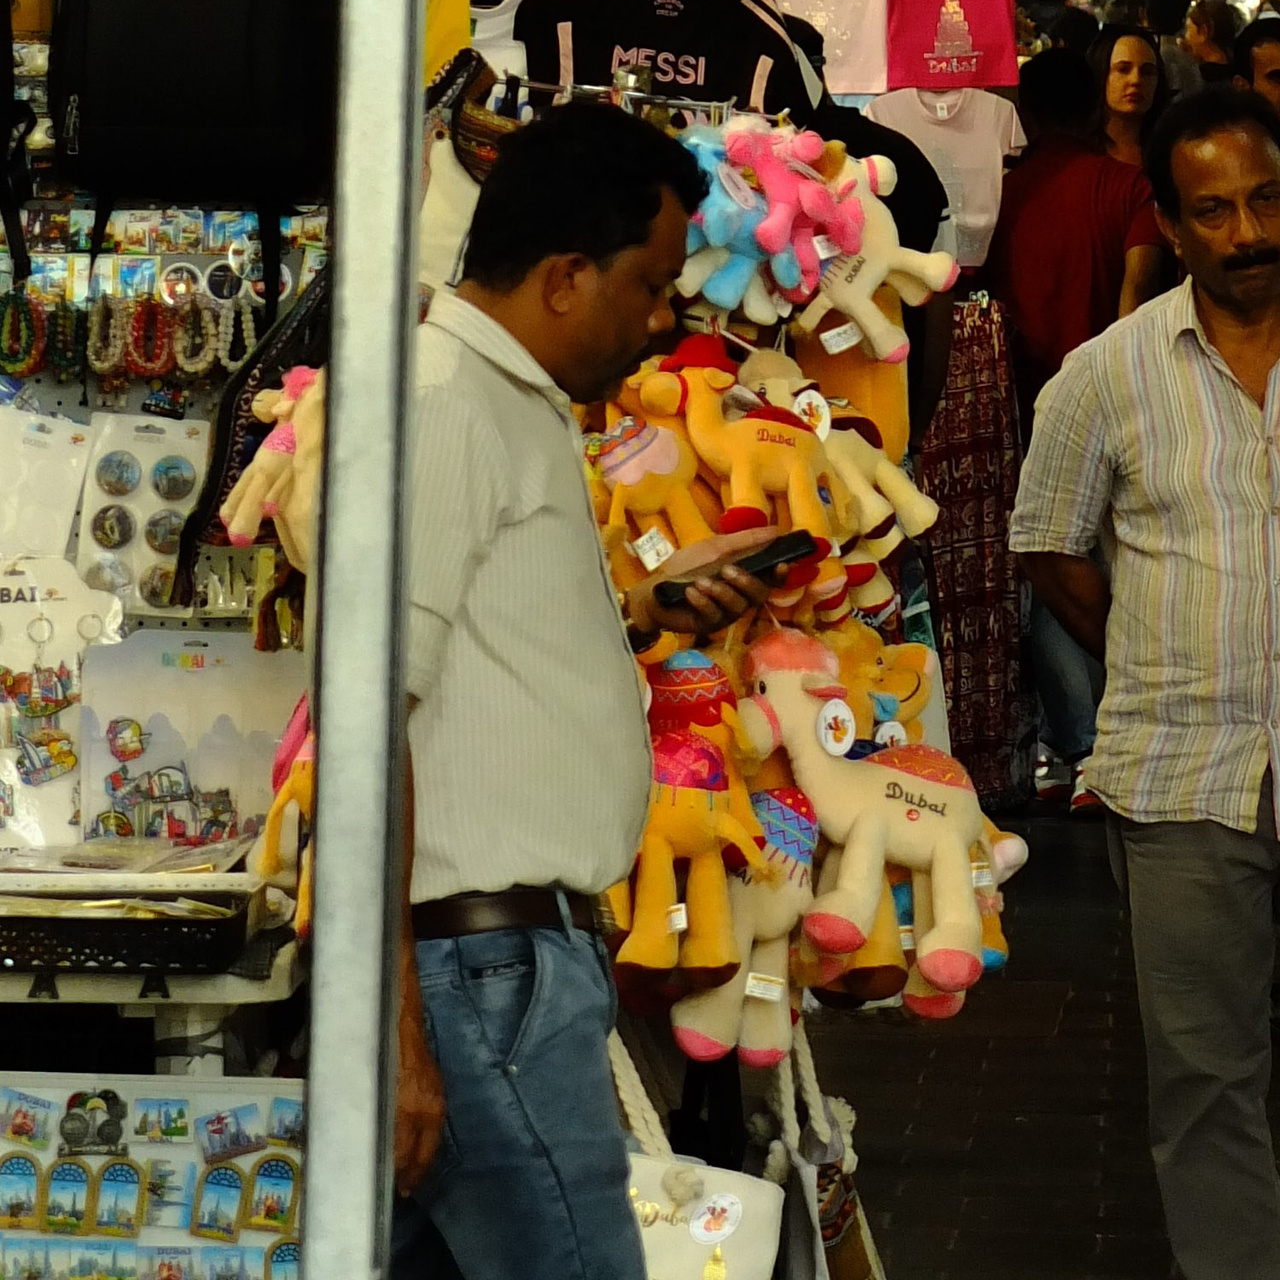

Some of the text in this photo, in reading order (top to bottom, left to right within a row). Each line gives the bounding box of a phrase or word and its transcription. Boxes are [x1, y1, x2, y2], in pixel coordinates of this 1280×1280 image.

[611, 44, 706, 86] MESSI
[757, 428, 797, 448] Dubai
[0, 586, 38, 603] BAI
[885, 782, 947, 817] Dubai
